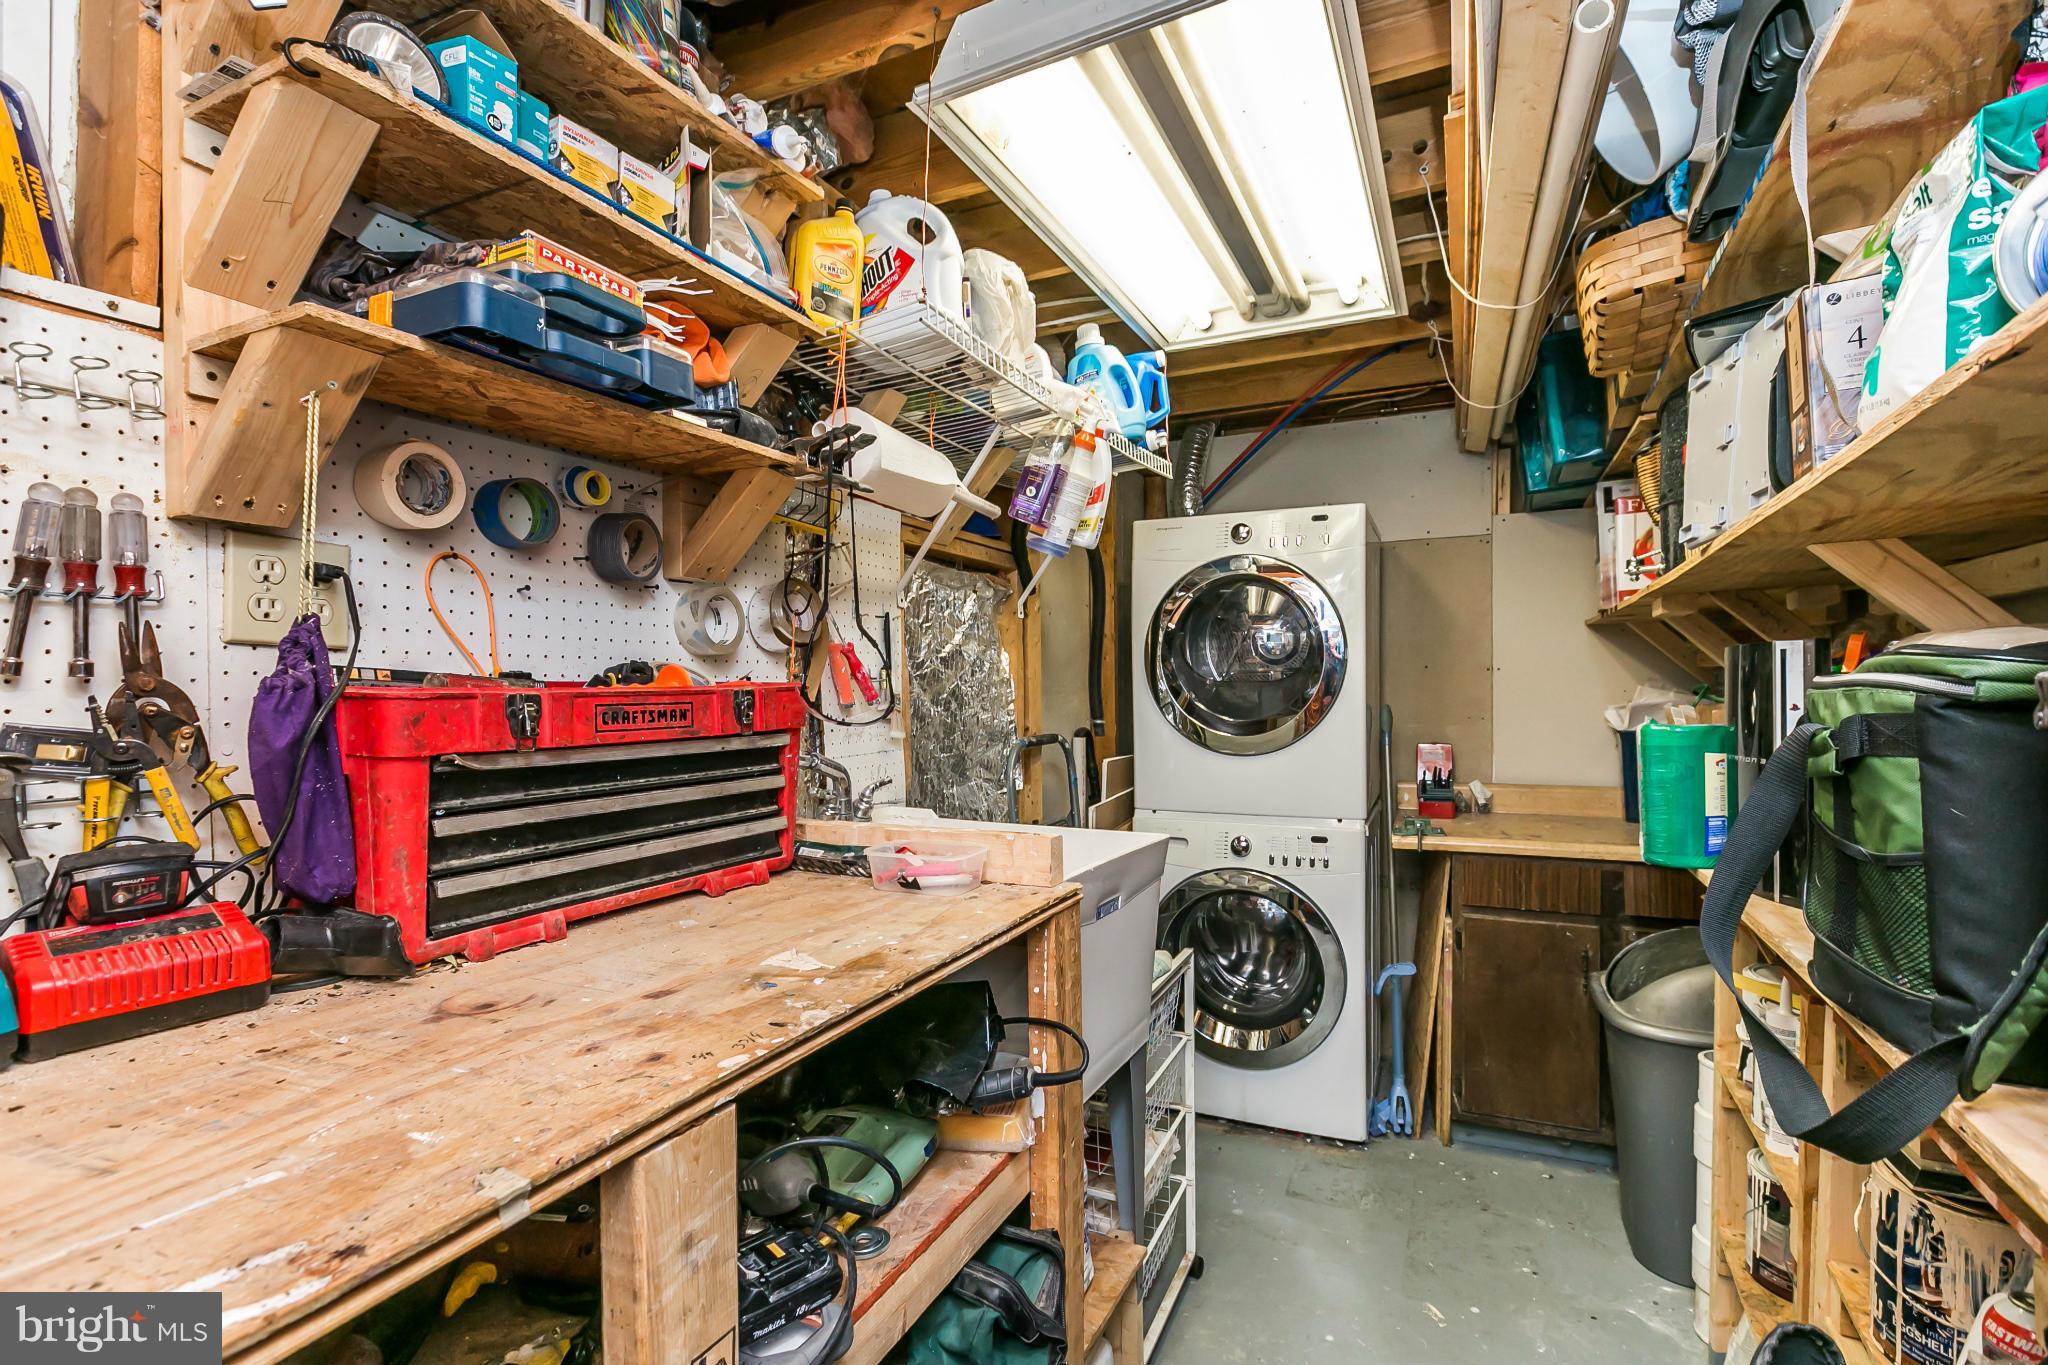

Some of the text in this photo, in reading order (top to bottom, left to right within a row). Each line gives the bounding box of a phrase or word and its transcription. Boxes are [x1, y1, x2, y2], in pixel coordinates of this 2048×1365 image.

[25, 162, 53, 221] IRWIN
[1846, 288, 1882, 300] LIBBEY
[1847, 324, 1868, 349] 4
[601, 708, 688, 726] CRAFTSMAN
[753, 1315, 786, 1340] makita
